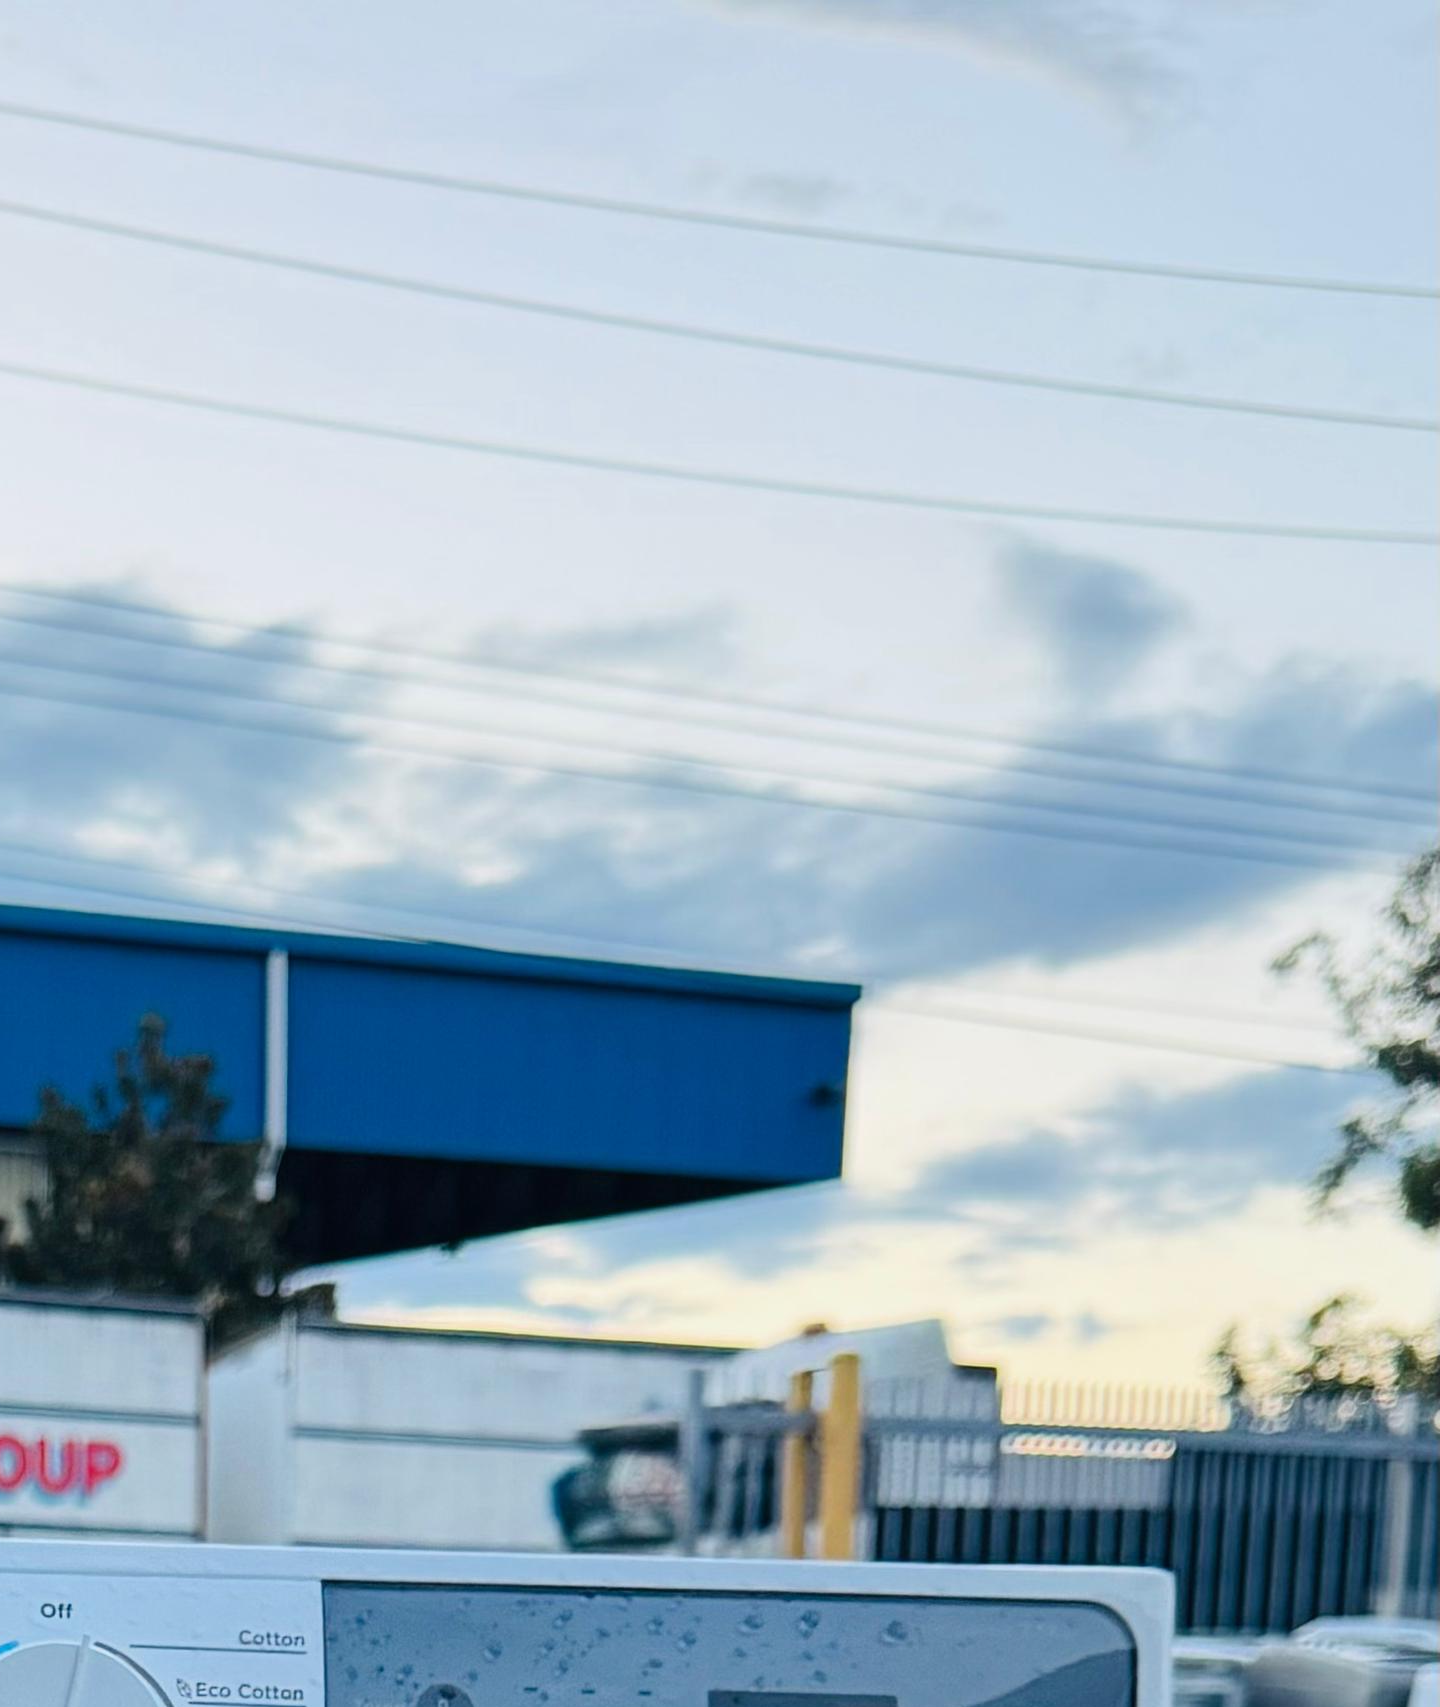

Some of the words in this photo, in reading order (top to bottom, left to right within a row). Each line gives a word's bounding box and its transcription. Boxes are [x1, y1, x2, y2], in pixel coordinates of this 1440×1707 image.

[40, 1602, 73, 1619] Off
[238, 1629, 306, 1648] Cotton
[195, 1681, 232, 1699] Eco
[238, 1683, 305, 1702] Cotton
